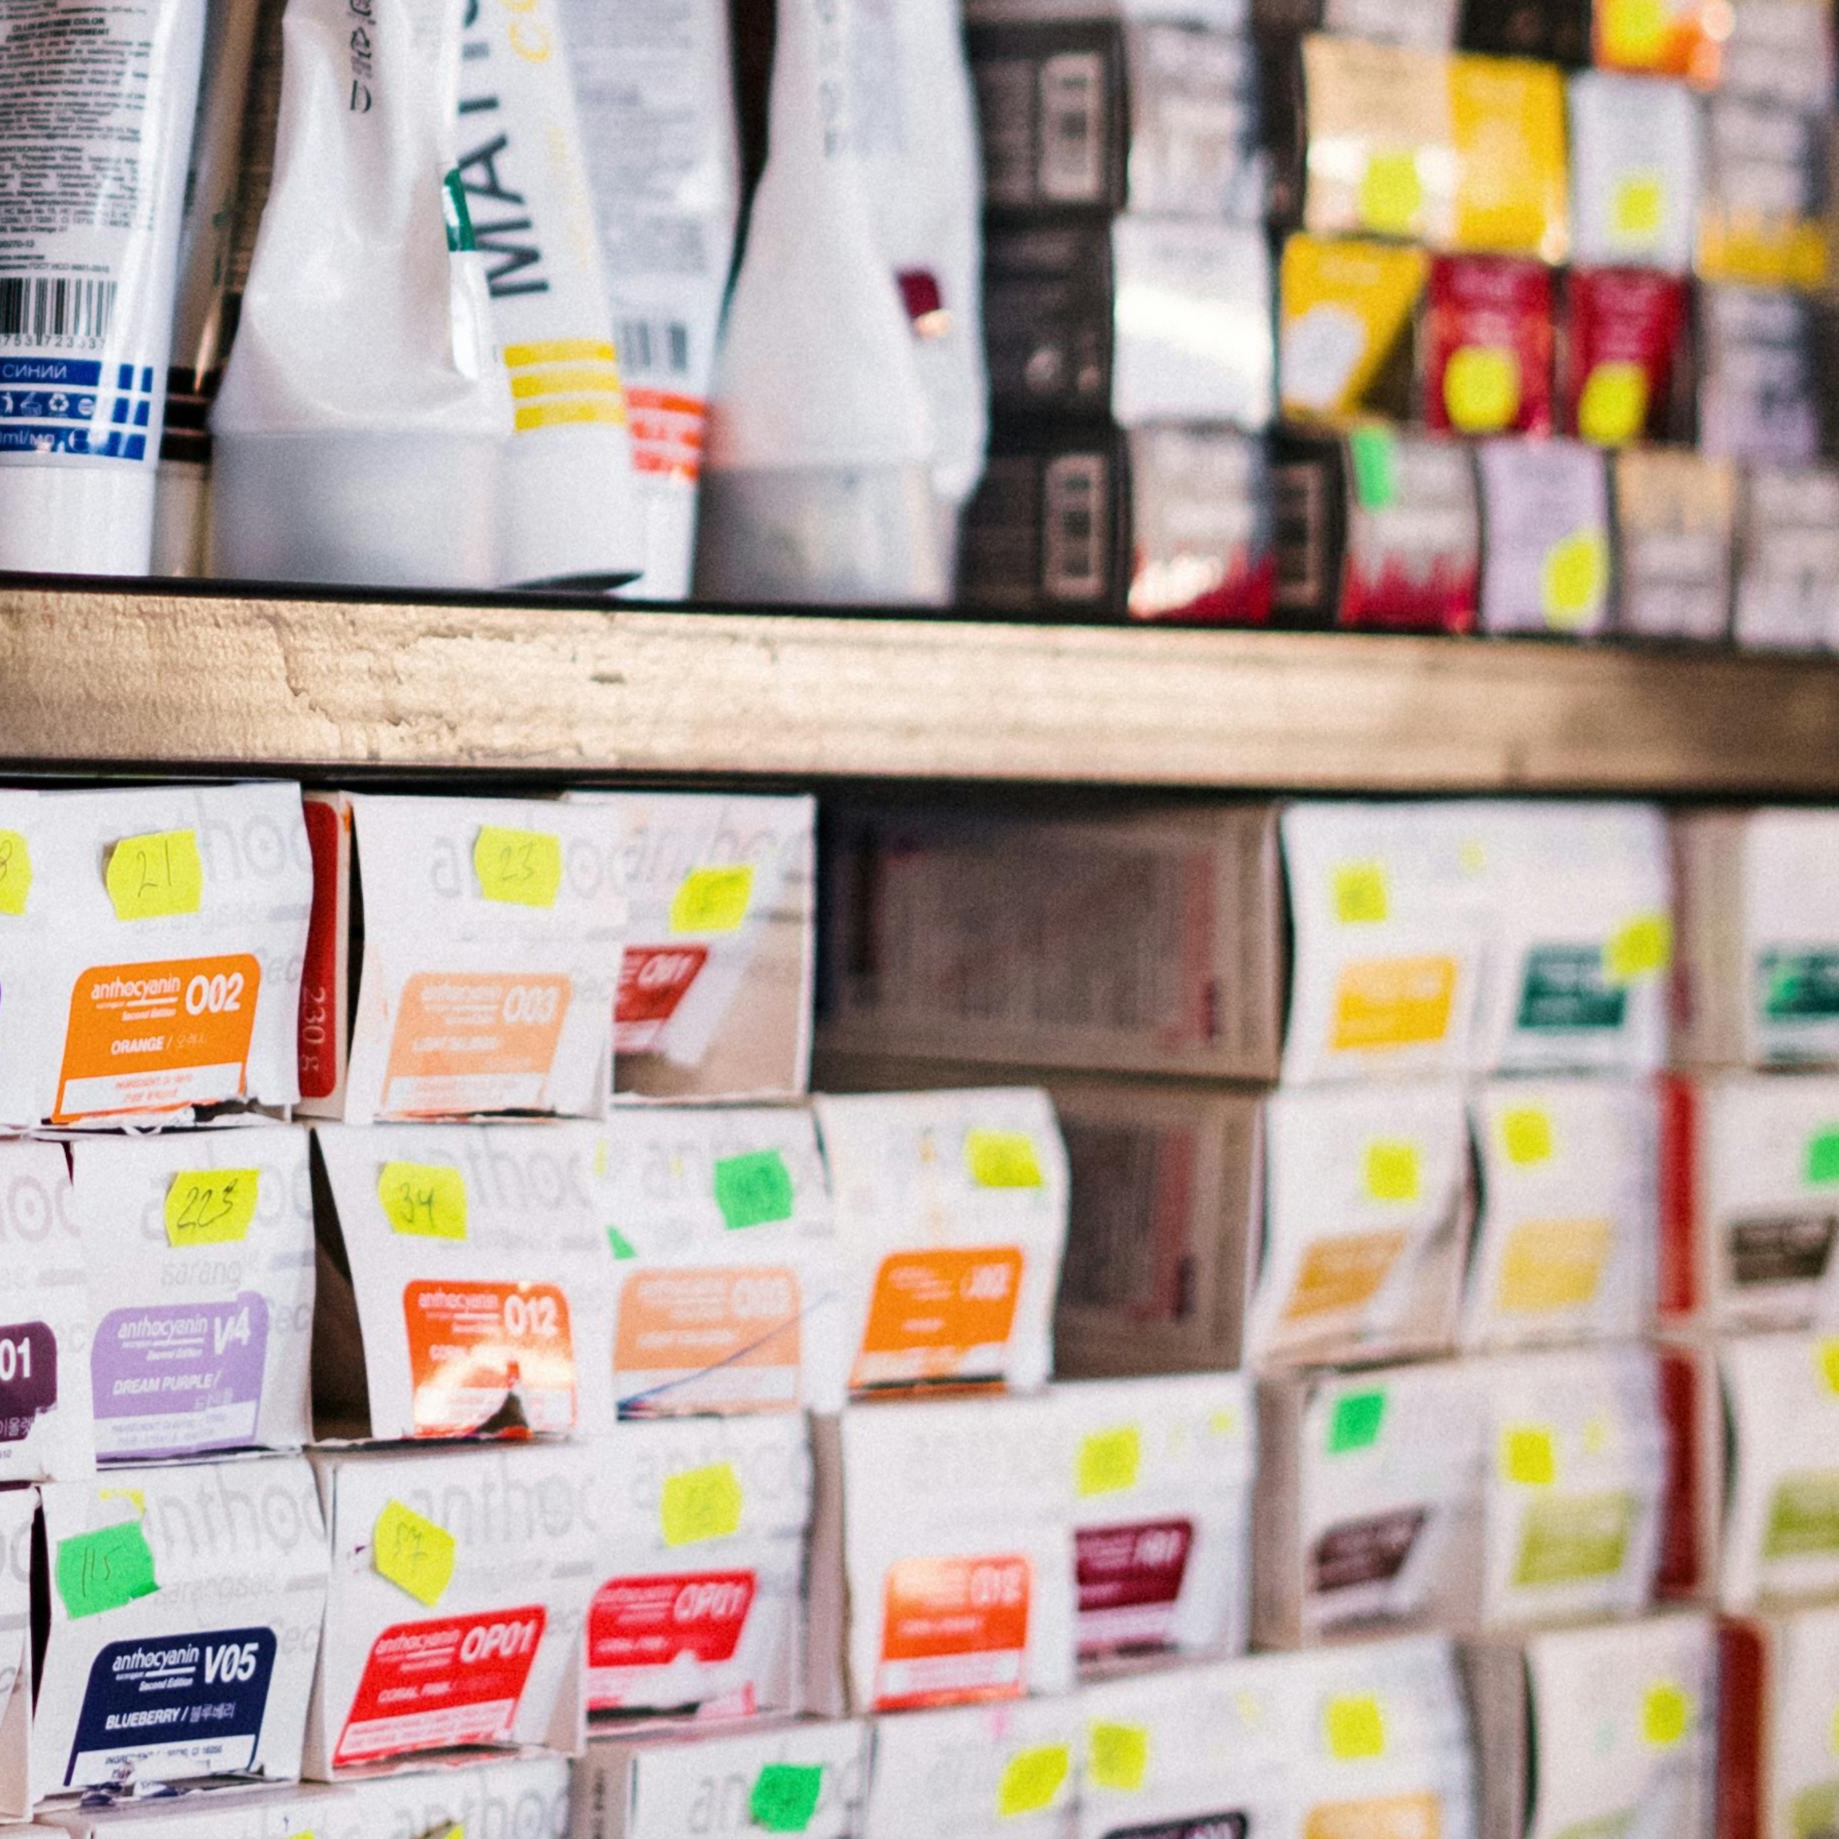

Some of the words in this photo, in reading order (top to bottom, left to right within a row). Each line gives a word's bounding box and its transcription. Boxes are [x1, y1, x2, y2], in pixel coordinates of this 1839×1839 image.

[2, 363, 68, 380] СИНИЙ
[91, 975, 181, 1002] anthocyanin
[111, 1036, 164, 1055] ORANGE
[118, 1314, 208, 1340] anthocyanin
[113, 1378, 159, 1396] DREAM
[162, 1374, 211, 1391] PURPLE
[112, 1643, 200, 1671] anthocyanin
[204, 1642, 259, 1684] V05
[138, 1679, 166, 1692] Second
[167, 1677, 194, 1688] Edition
[105, 1708, 180, 1730] BLUEBERRY
